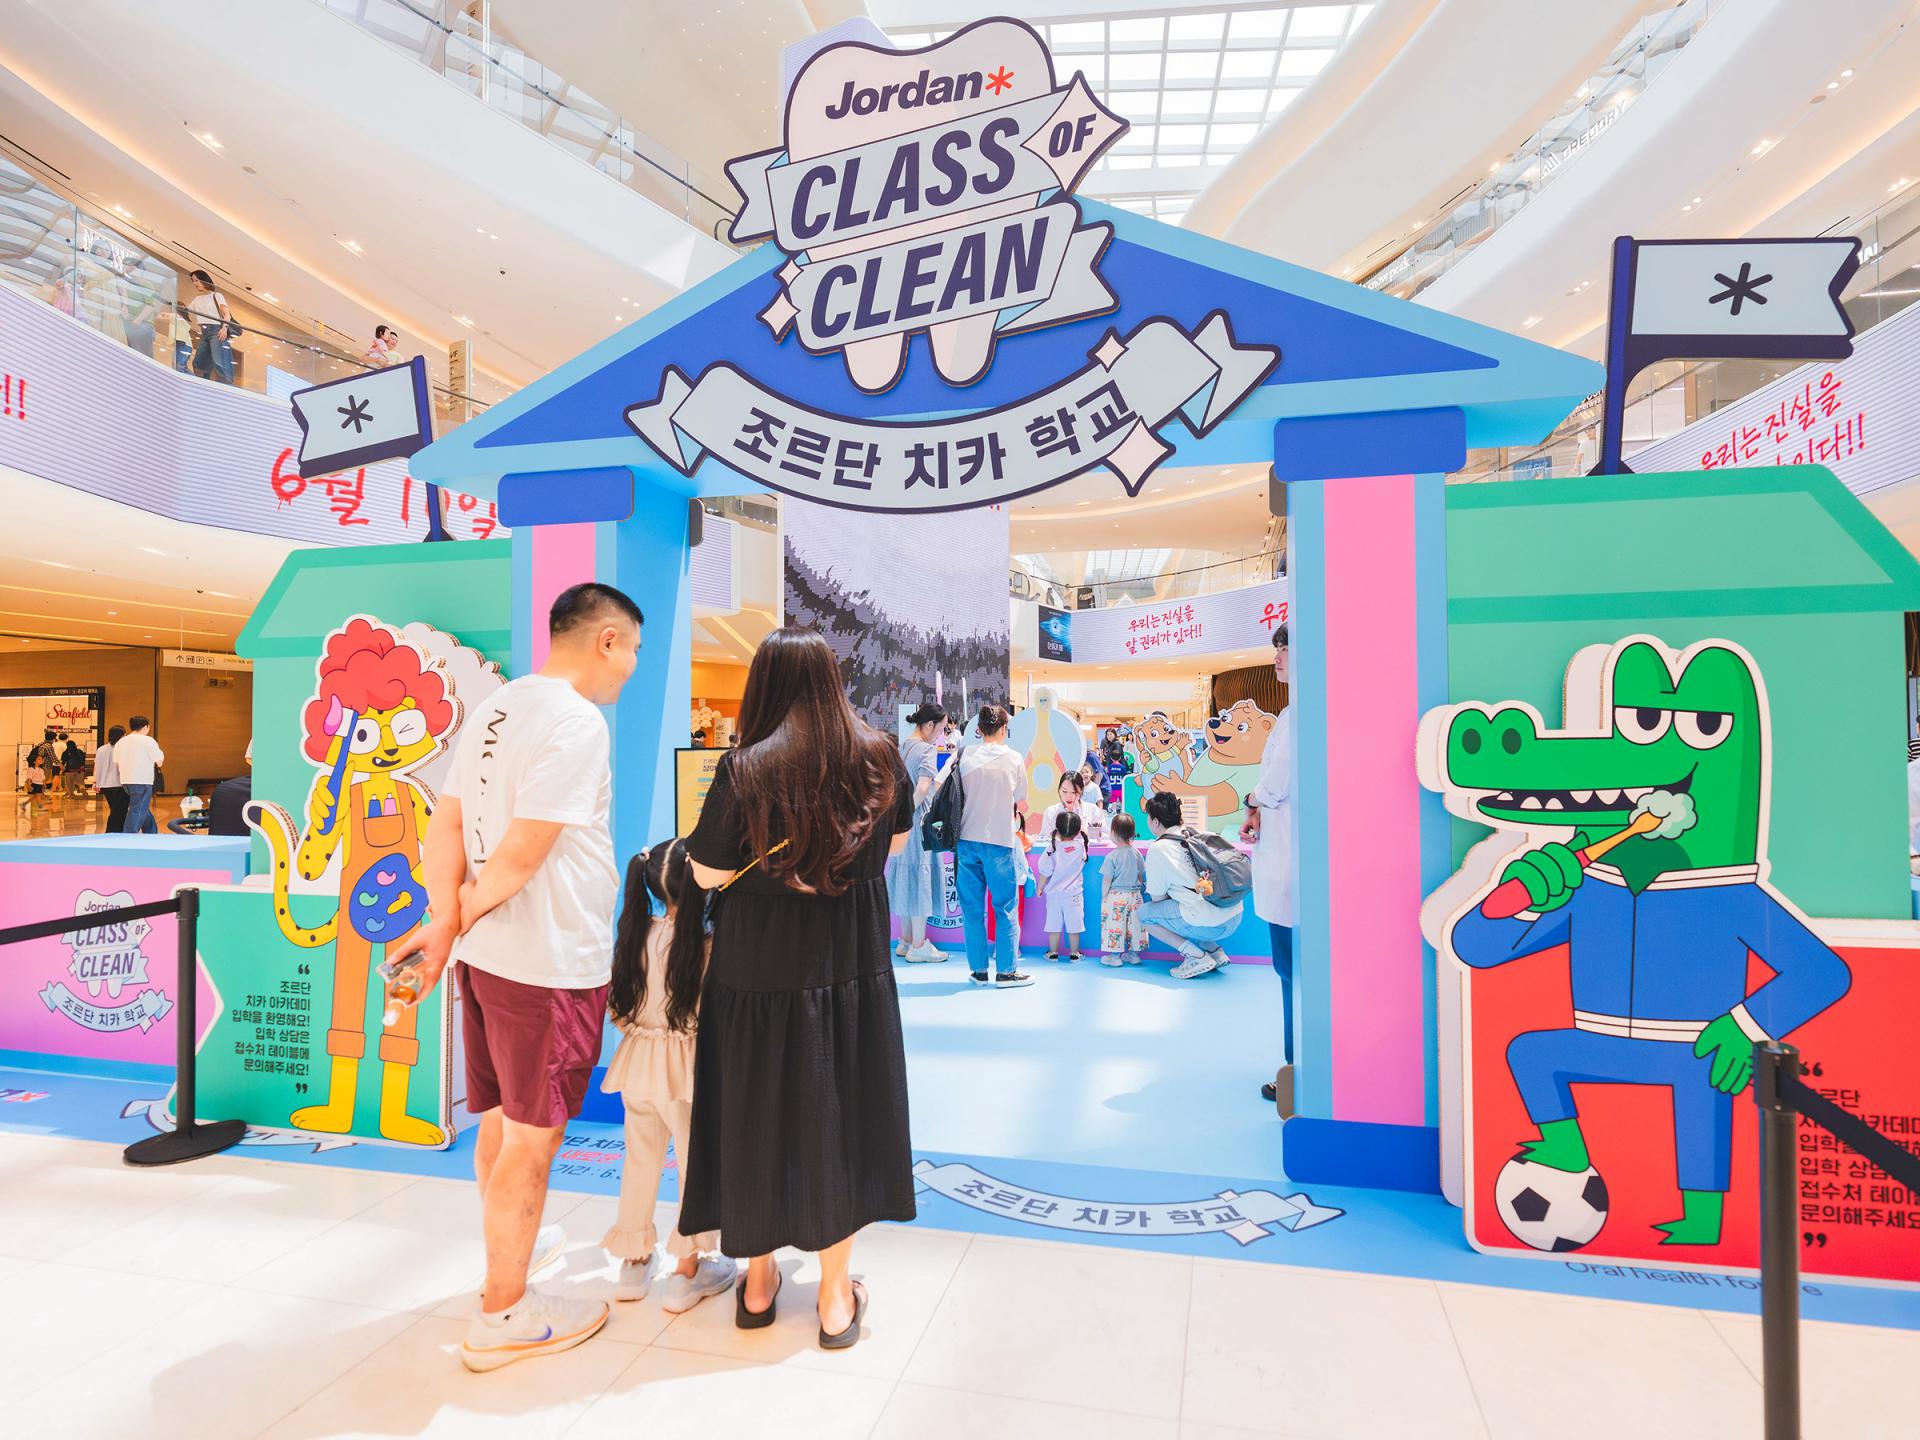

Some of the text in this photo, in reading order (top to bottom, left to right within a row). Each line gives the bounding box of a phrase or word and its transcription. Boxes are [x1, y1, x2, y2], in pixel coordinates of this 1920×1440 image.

[825, 70, 983, 119] Jordan
[1562, 99, 1626, 160] GREGORY
[791, 113, 1098, 239] CLASS OF
[811, 216, 1050, 338] CLEAN
[1701, 371, 1841, 470] 우리는 진실을
[732, 379, 1139, 490] 조르단 치카 학교
[1128, 604, 1195, 632] 우리는 진실을
[1125, 623, 1203, 655] 알 권리가 있다!!
[46, 703, 92, 726] Starfield
[76, 921, 146, 947] CLASS OF
[80, 952, 135, 978] CLEAN
[281, 981, 311, 995] 조르단
[62, 996, 146, 1026] 조르단 치카 학교
[246, 995, 311, 1011] 치카 아카데미
[265, 1012, 311, 1027] 환영해요!
[255, 1027, 310, 1044] 입학 상담은
[235, 1042, 310, 1060] 접수처 테이블에
[244, 1058, 309, 1076] 문의해주세요!
[1817, 1089, 1861, 1108] 르단
[1800, 1157, 1841, 1177] 입학
[953, 1179, 1247, 1229] 조르단 치카 학교
[1801, 1181, 1862, 1202] 접수처
[1566, 1262, 1625, 1274] Oral
[1630, 1267, 1721, 1288] health
